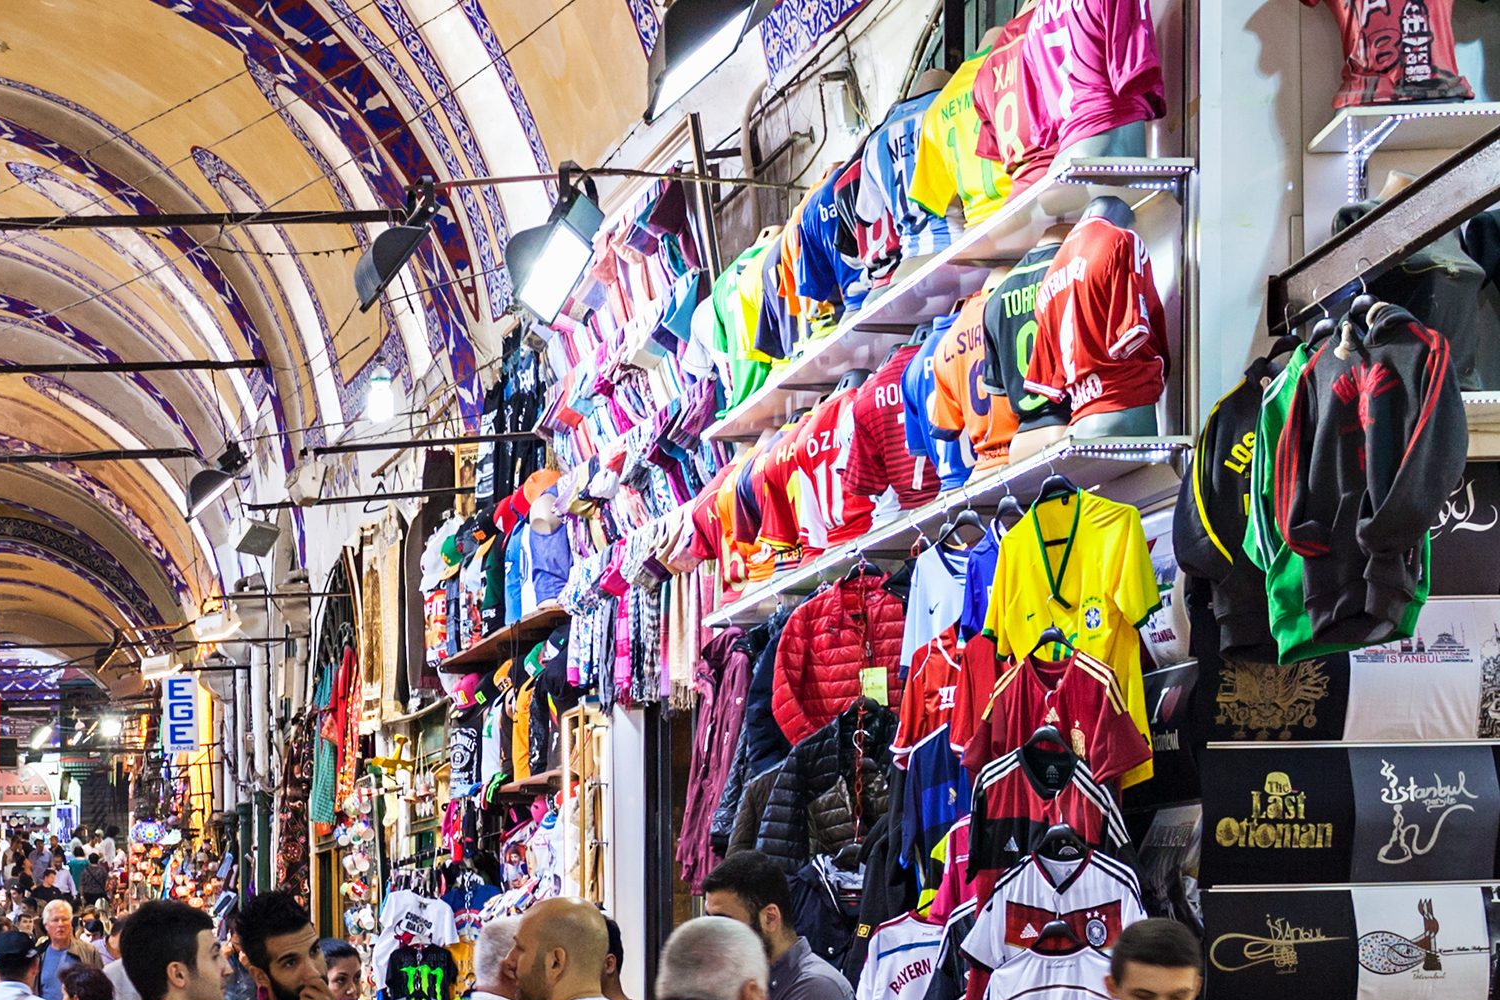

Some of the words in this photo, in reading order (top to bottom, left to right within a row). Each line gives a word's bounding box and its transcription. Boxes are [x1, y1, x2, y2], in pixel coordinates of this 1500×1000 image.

[1386, 654, 1441, 664] ISTANBUL
[168, 678, 194, 745] EGE
[5, 784, 47, 796] SILVER
[1250, 790, 1307, 820] Last
[1215, 816, 1333, 849] Ottoman
[889, 958, 932, 996] BAYERN
